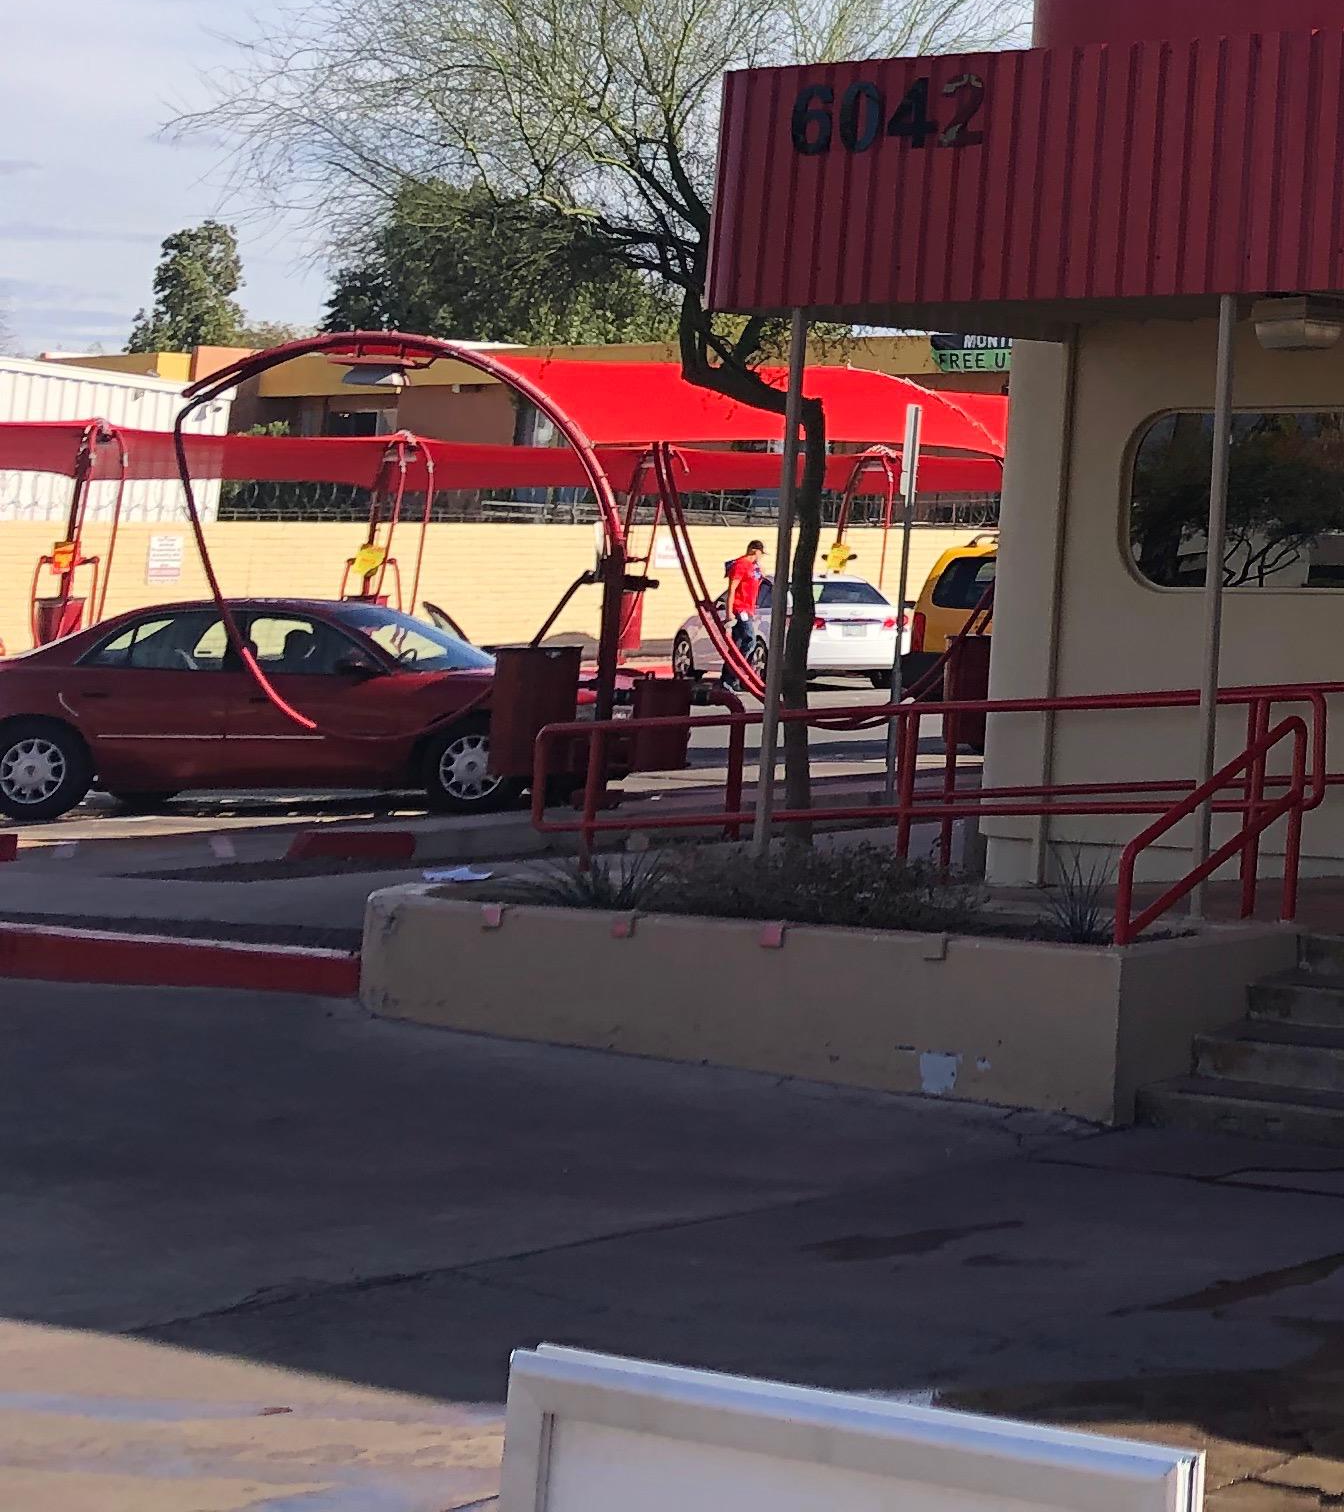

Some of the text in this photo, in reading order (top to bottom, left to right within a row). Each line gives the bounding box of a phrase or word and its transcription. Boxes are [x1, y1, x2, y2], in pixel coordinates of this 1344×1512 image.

[790, 74, 985, 156] 6042
[938, 352, 1012, 369] FREE U
